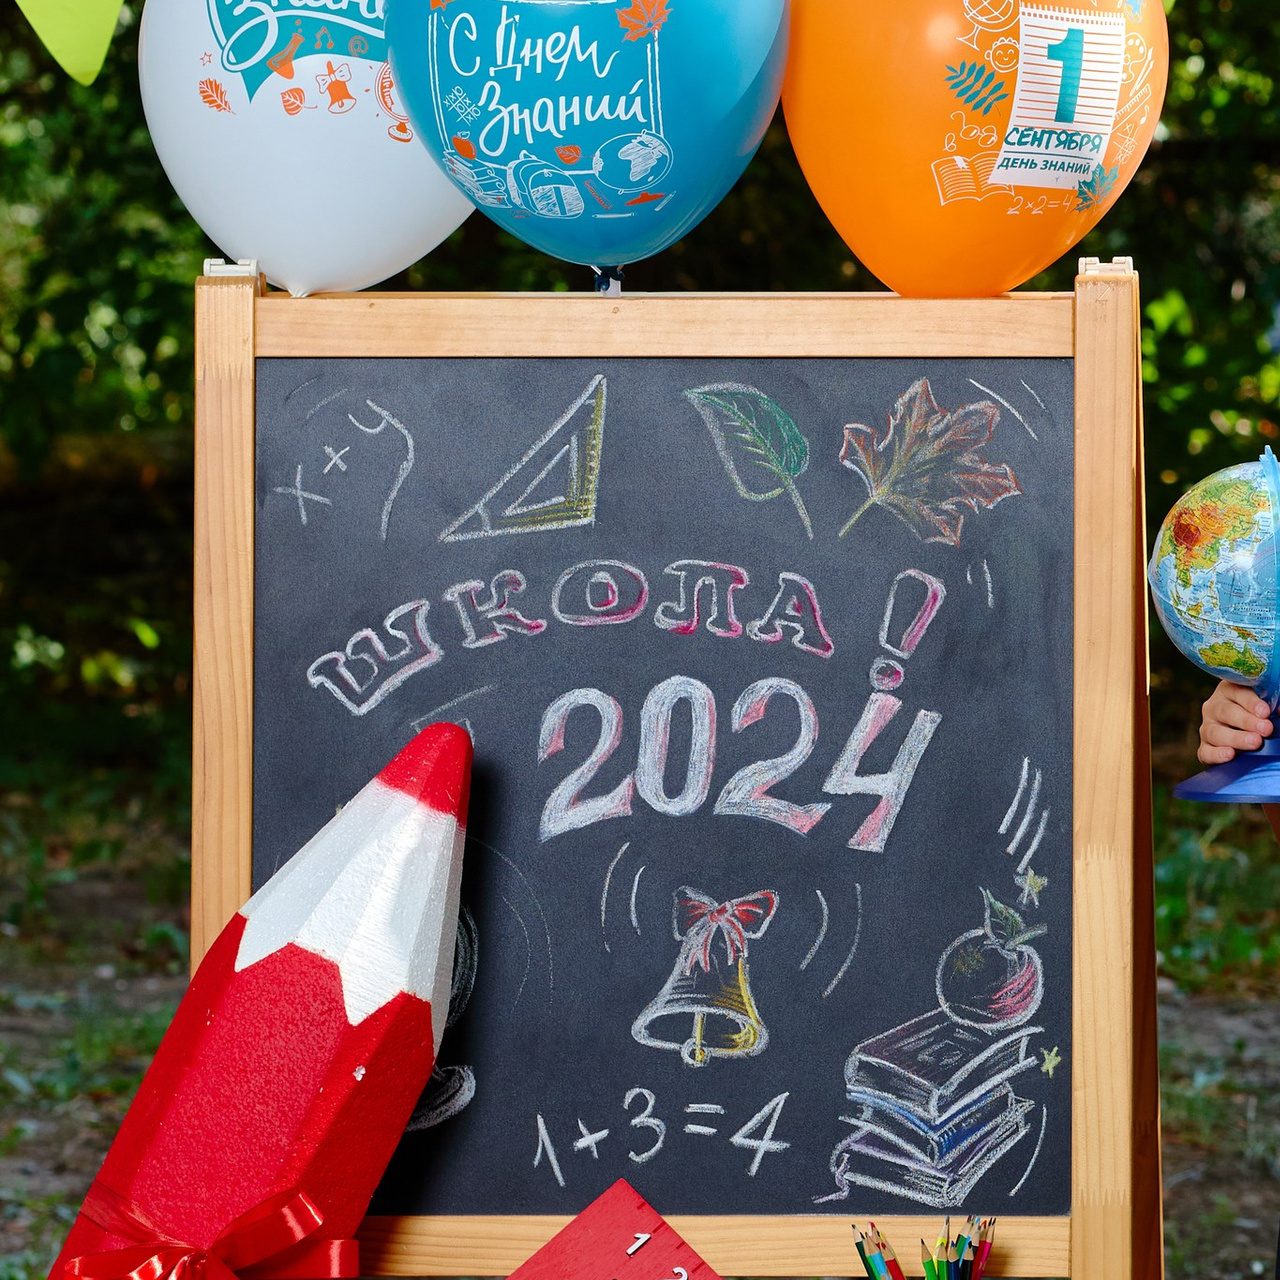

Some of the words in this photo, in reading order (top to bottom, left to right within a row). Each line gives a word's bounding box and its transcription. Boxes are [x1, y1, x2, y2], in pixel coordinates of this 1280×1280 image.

[449, 12, 480, 76] С
[489, 5, 620, 81] Днем
[1047, 28, 1085, 123] 1
[477, 79, 648, 157] Знаний
[1003, 126, 1103, 154] СЕНТЯБРЯ
[997, 155, 1038, 171] ДЕНЬ
[1039, 157, 1091, 175] ЗНАНИЙ
[538, 675, 943, 854] 2024
[624, 1231, 652, 1257] 1
